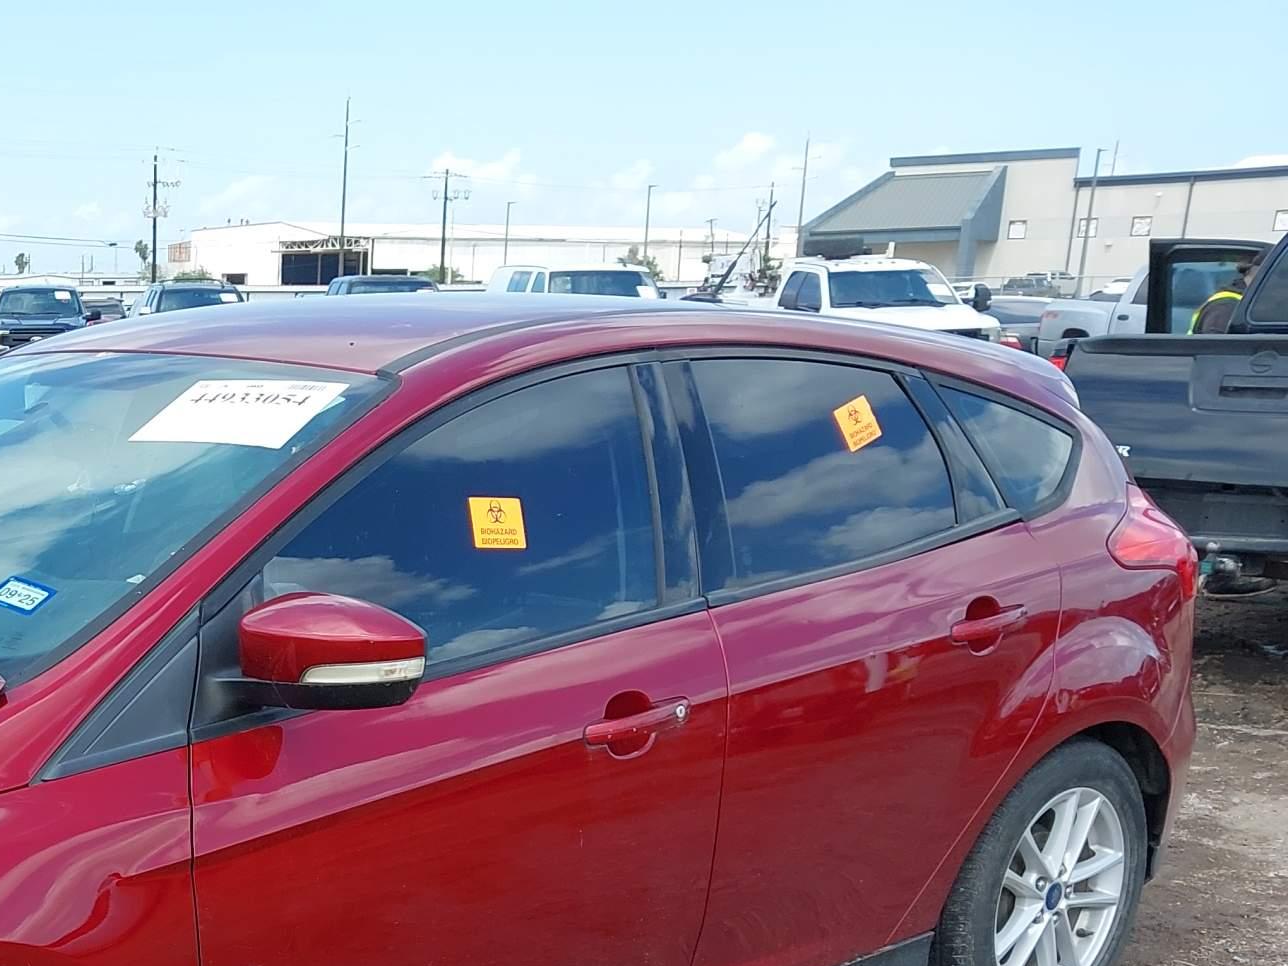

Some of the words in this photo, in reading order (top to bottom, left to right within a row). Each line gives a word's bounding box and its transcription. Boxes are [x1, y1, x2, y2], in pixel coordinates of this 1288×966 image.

[190, 392, 312, 406] 44933054
[480, 527, 518, 536] BIOHAZARD
[17, 593, 40, 606] 25
